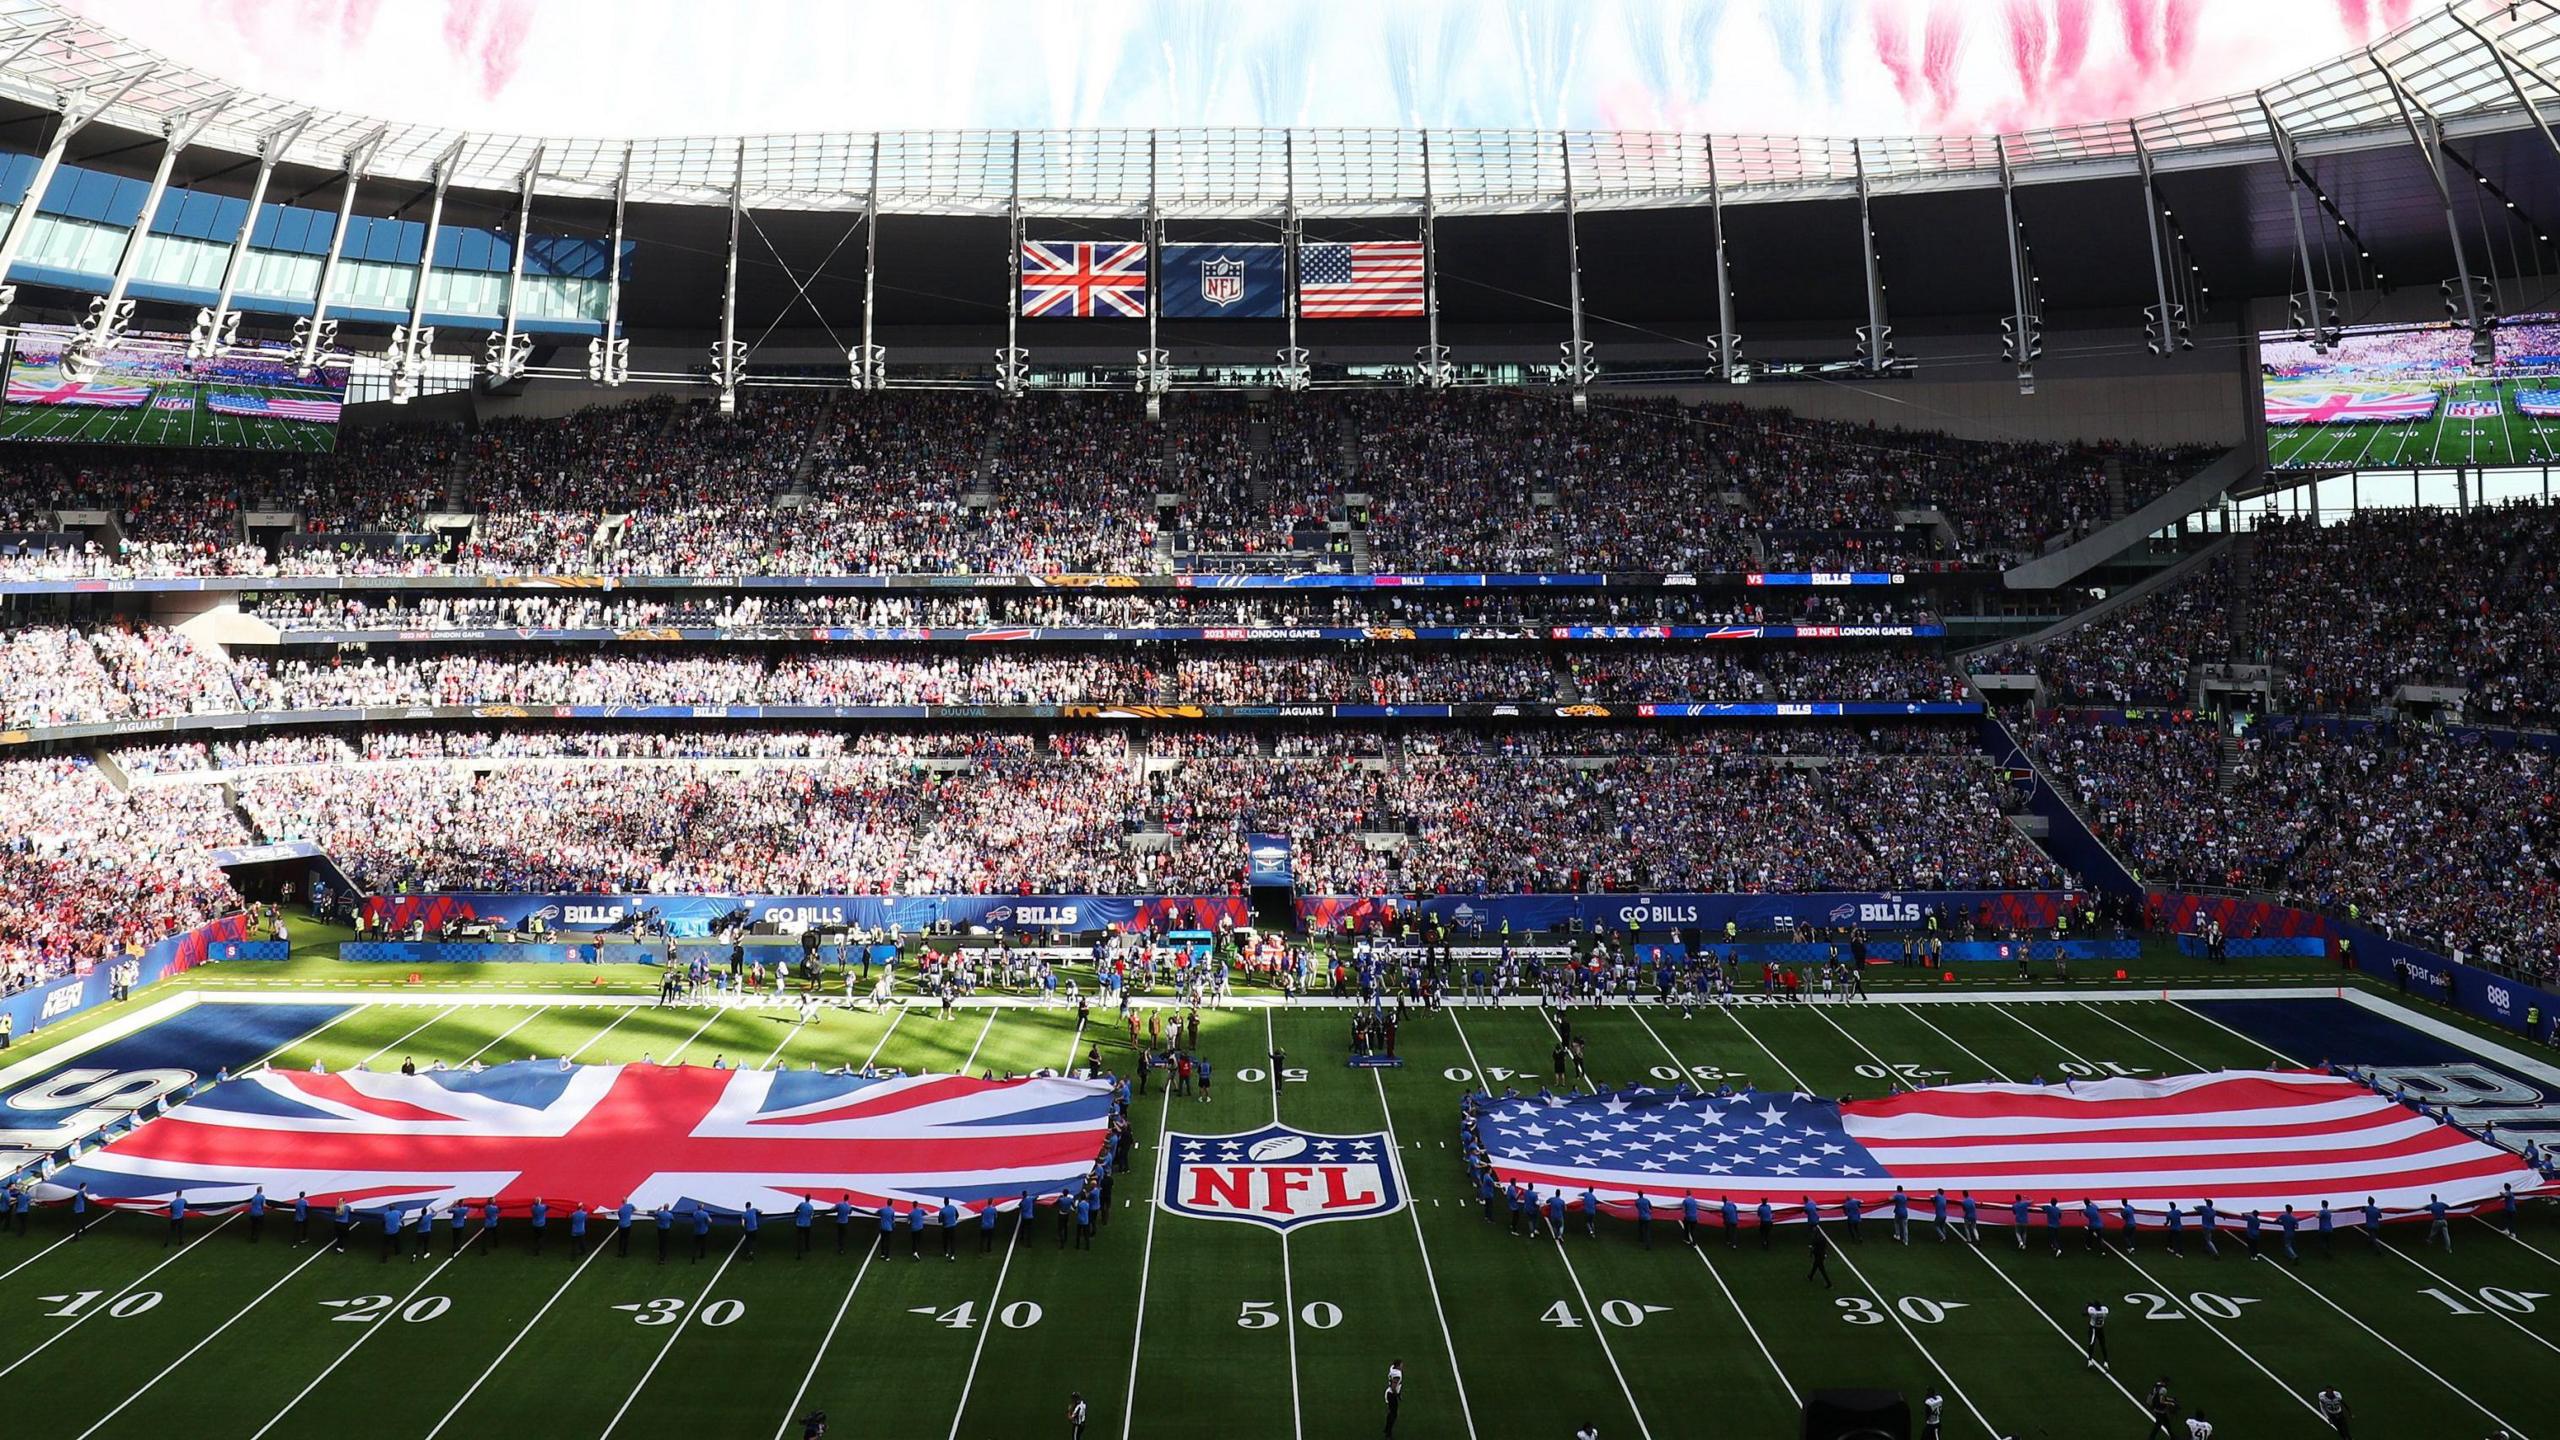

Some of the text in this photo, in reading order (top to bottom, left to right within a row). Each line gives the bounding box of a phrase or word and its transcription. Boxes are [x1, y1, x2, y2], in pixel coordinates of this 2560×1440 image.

[1208, 278, 1239, 296] NFL
[2452, 407, 2495, 417] NFL
[108, 581, 134, 591] BILLS
[692, 577, 734, 586] JAGUARS
[974, 577, 1016, 586] JAGUARS
[1178, 577, 1191, 586] VS
[1401, 576, 1424, 585] BILLS
[1663, 577, 1697, 586] JAGUARS
[1749, 573, 1851, 585] VS BILLS
[431, 631, 460, 639] LONDON
[814, 629, 829, 639] VS
[1226, 630, 1245, 638] NFL
[1247, 629, 1287, 639] LONDON
[1289, 629, 1321, 638] GAMES
[1554, 628, 1568, 637] VS
[1819, 627, 1838, 636] NFL
[1839, 627, 1878, 636] LONDON
[1881, 627, 1912, 635] GAMES
[556, 705, 727, 717] VS BILLS
[1280, 707, 1324, 716] JAGUARS
[1639, 704, 1812, 715] VS BILLS
[114, 720, 164, 733] JAGUARS
[564, 905, 624, 923] BILLS
[765, 906, 843, 924] GO BILLS
[1016, 906, 1077, 925] BILLS
[1619, 905, 1698, 923] GO BILLS
[1860, 904, 1920, 922] BILLS
[41, 991, 82, 1020] MEN
[2487, 984, 2510, 1009] 888
[1187, 1167, 1376, 1214] NFL
[44, 1290, 164, 1318] 10
[331, 1295, 452, 1323] 20
[2123, 1292, 2242, 1319] 20
[2416, 1286, 2536, 1314] 10
[634, 1299, 745, 1326] 30
[935, 1301, 1043, 1329] 40
[1237, 1302, 1343, 1329] 50
[1540, 1300, 1645, 1328] 40
[1835, 1296, 1945, 1325] 30
